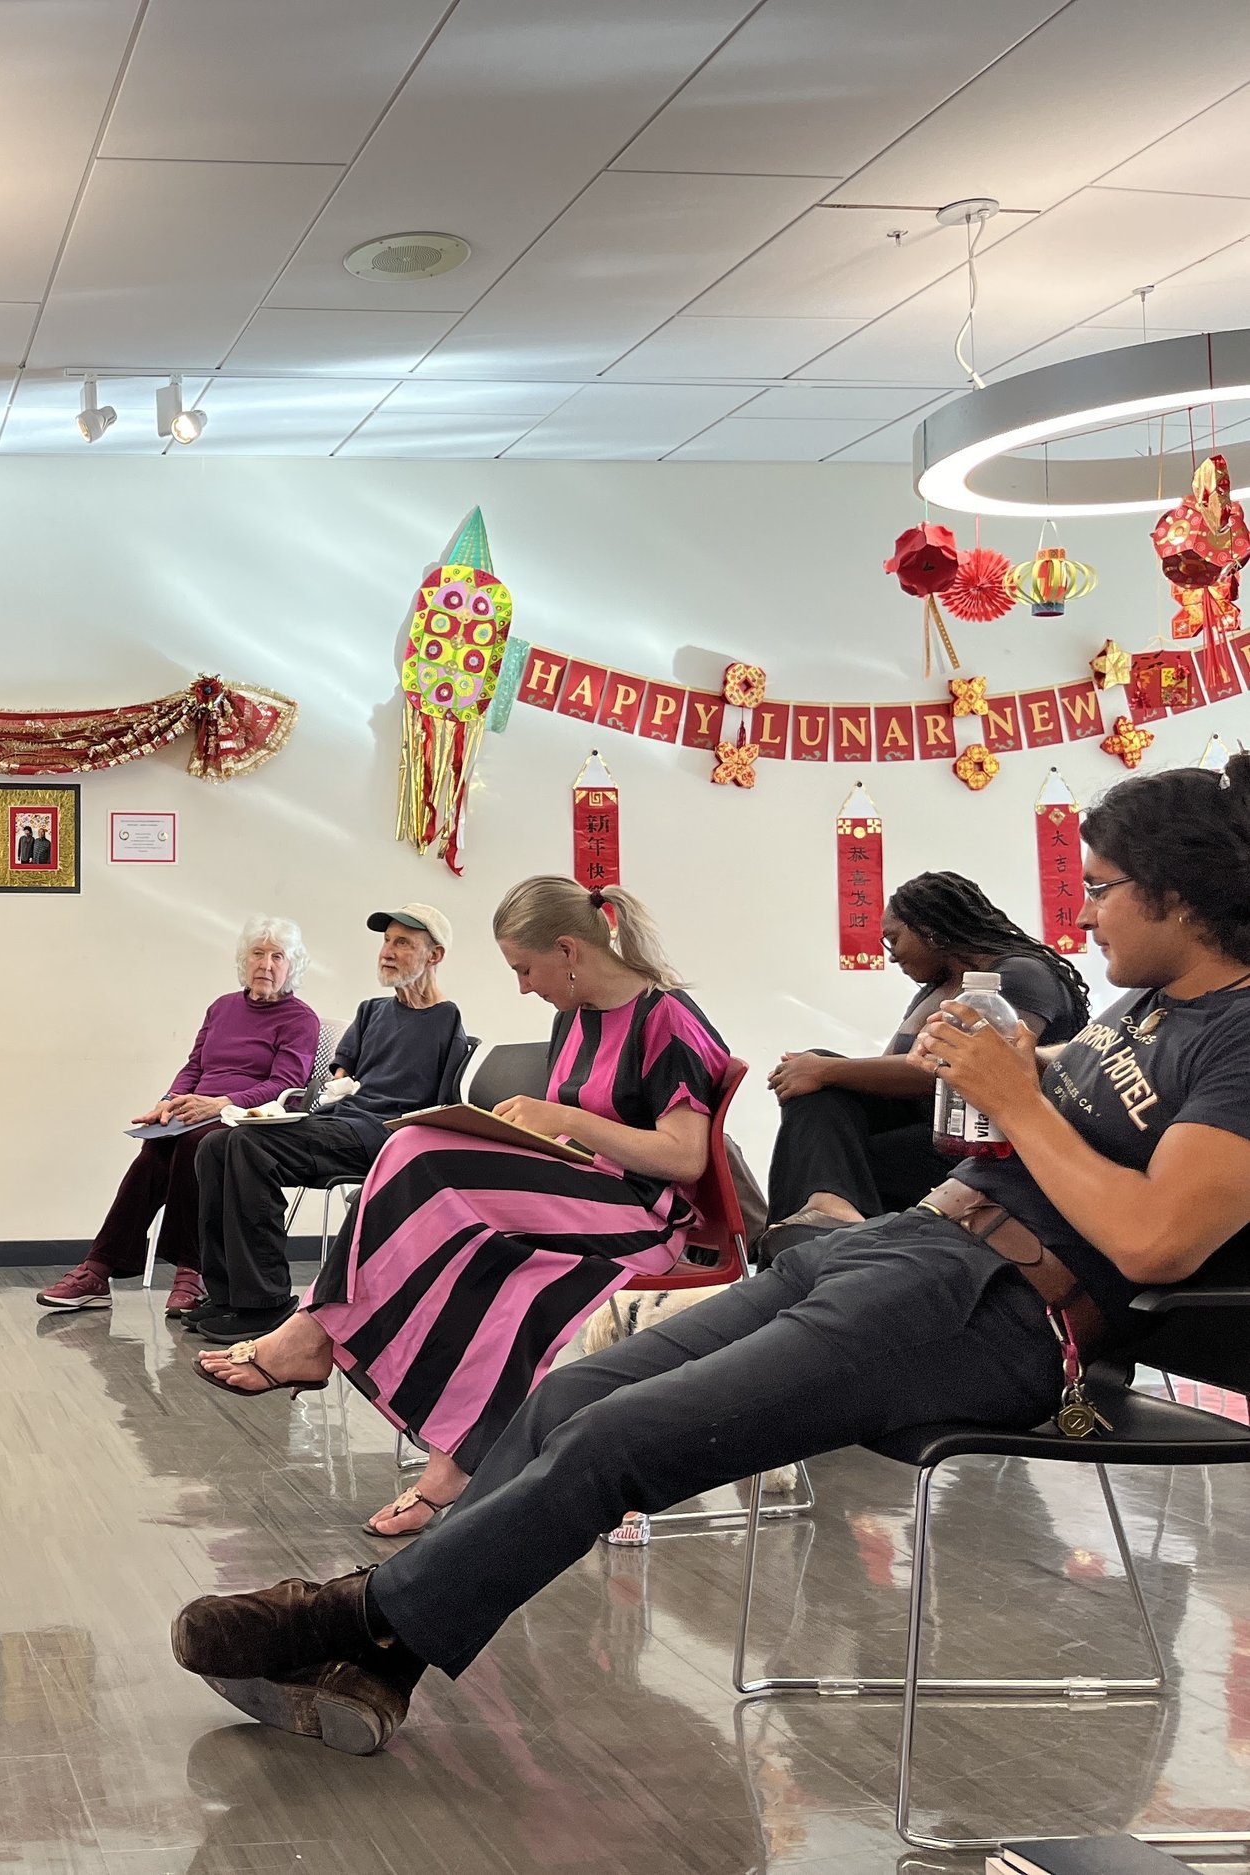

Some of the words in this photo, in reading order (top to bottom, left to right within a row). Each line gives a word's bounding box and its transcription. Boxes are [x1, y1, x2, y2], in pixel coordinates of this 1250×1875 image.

[526, 658, 719, 734] HAPPY
[759, 712, 951, 747] LUNAR
[987, 691, 1097, 739] NEW
[1051, 830, 1073, 927] 大吉大利
[1079, 1098, 1093, 1114] CA
[1100, 1046, 1158, 1132] HOTEL
